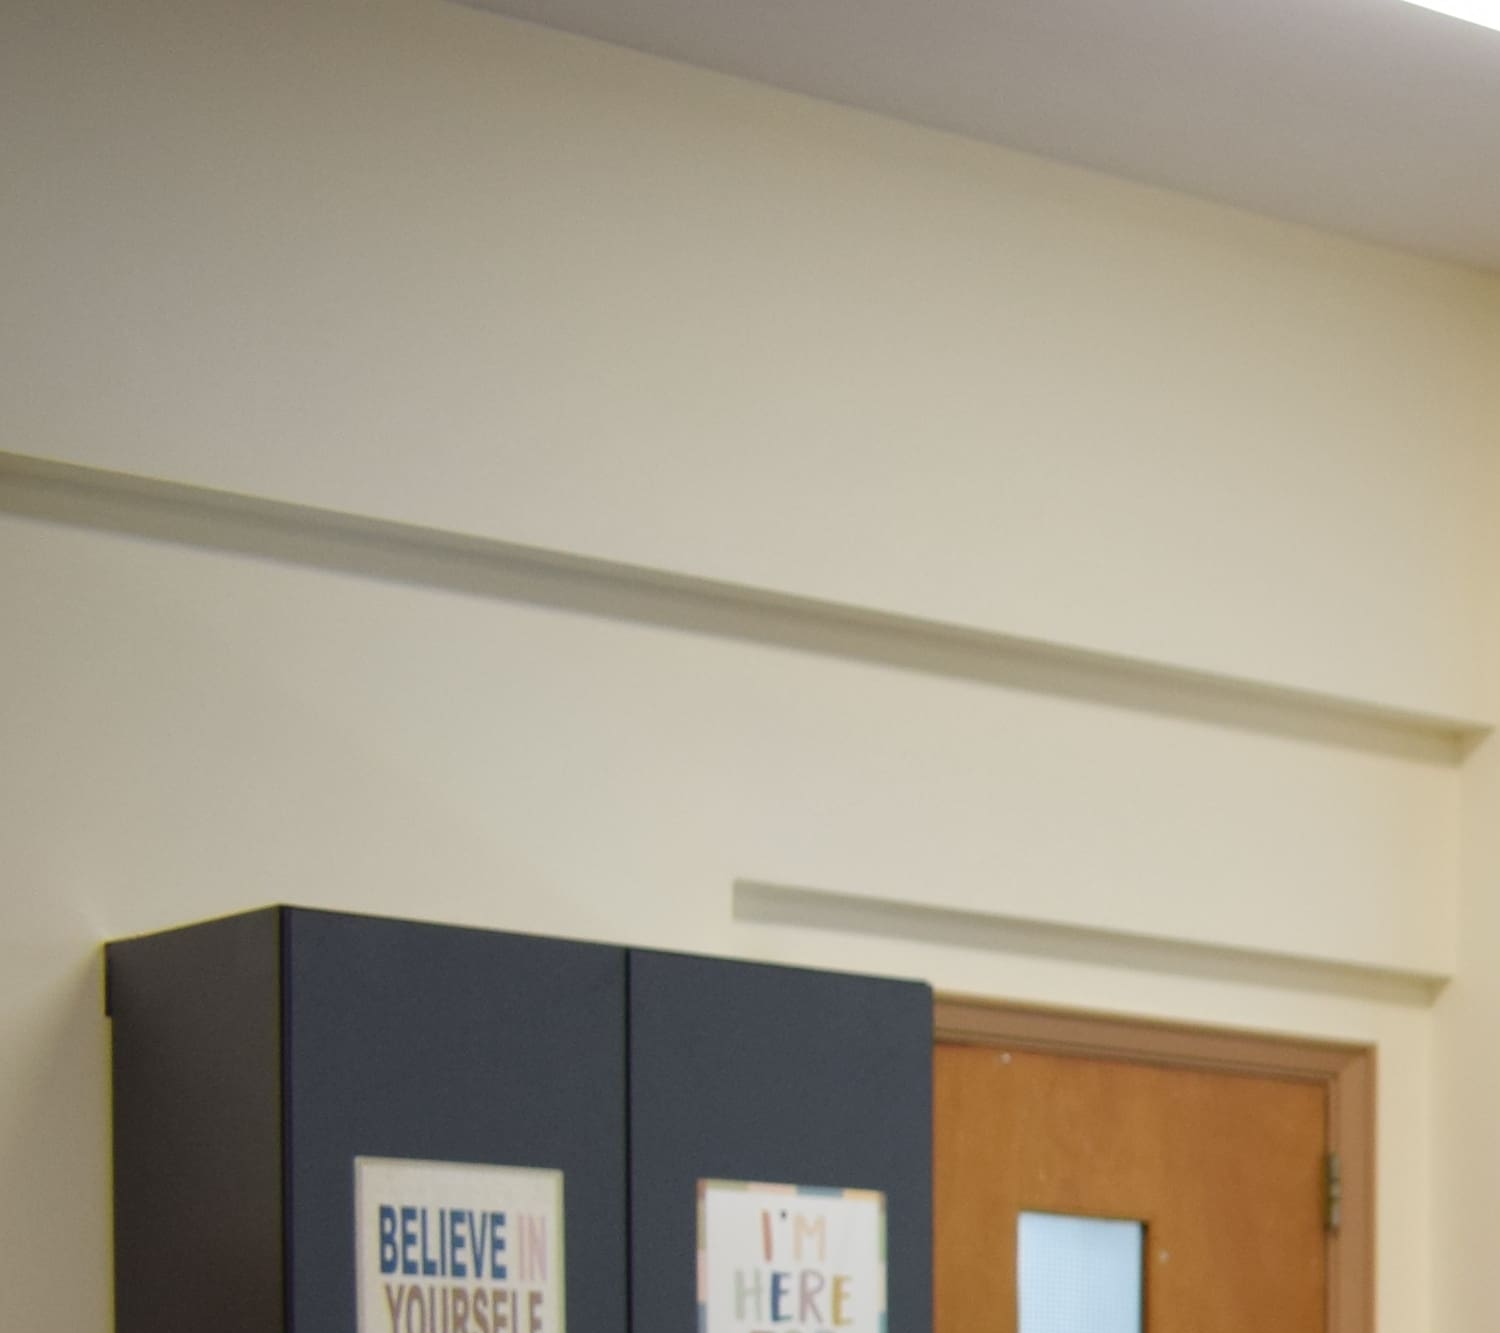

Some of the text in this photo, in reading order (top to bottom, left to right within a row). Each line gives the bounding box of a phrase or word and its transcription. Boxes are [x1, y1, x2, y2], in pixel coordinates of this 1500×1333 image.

[379, 1204, 547, 1281] BELIEVE IN
[761, 1209, 826, 1263] I'M
[734, 1267, 853, 1327] HERE
